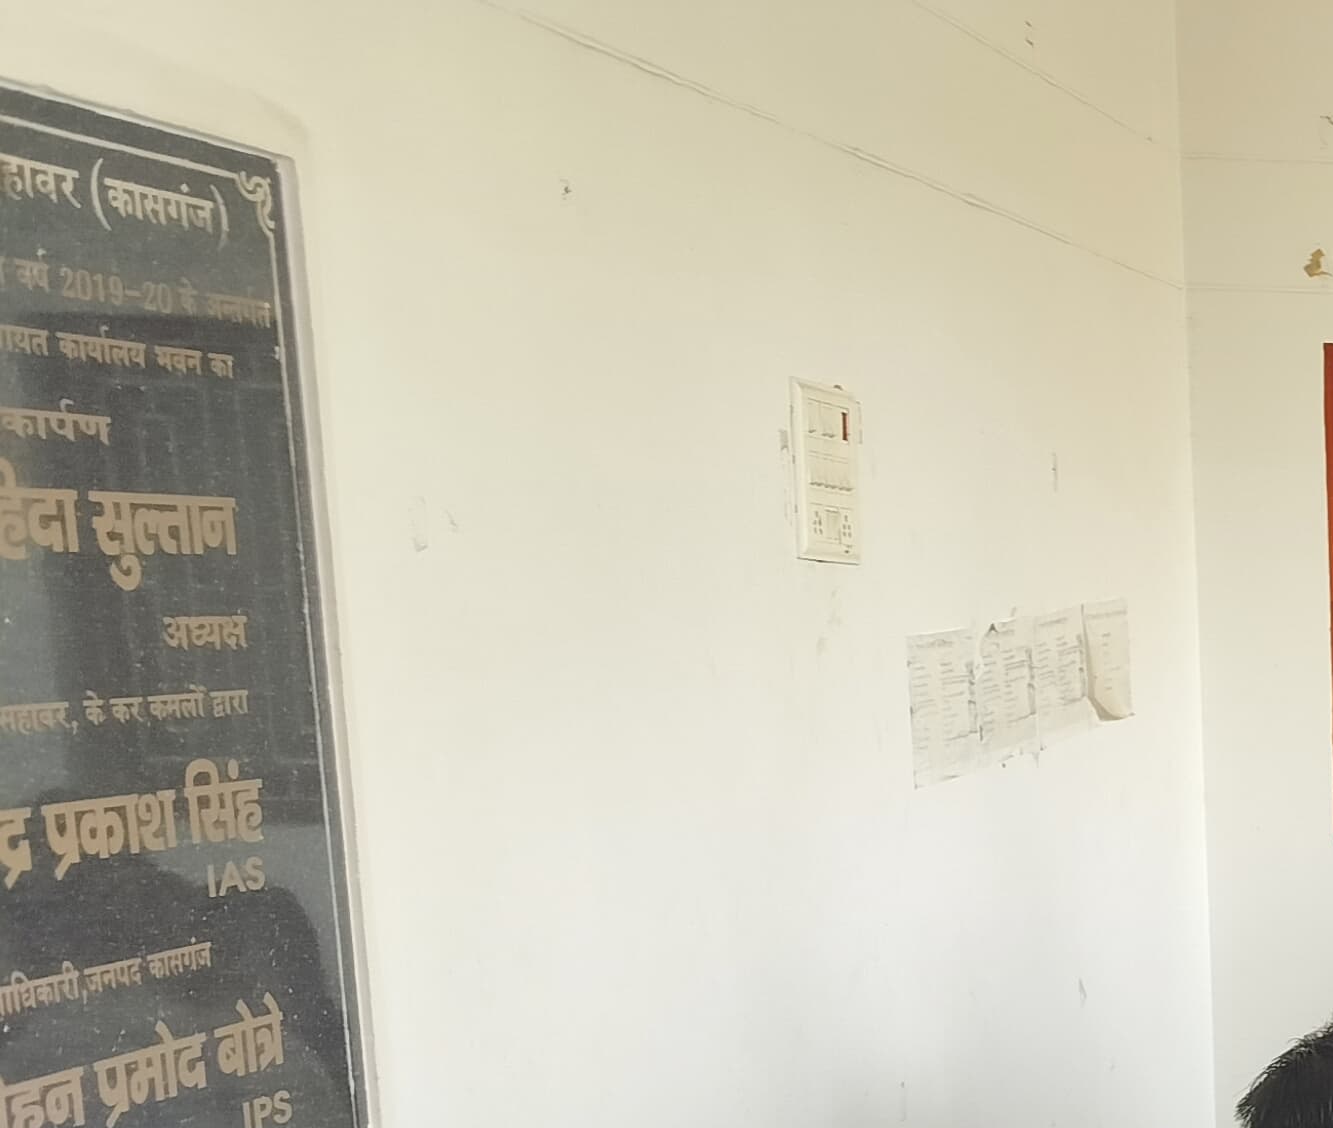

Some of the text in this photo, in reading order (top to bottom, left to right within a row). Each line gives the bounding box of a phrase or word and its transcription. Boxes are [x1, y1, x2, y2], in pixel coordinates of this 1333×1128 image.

[0, 154, 230, 249] हावर (कासगंज)
[55, 325, 146, 368] कार्यालय
[154, 345, 202, 374] भवन
[208, 353, 234, 378] का
[0, 399, 111, 445] कार्पण
[89, 491, 237, 591] सुल्तान
[163, 615, 248, 650] अध्यक्ष
[83, 690, 106, 725] के
[109, 697, 144, 723] कर
[147, 684, 207, 720] कमलों
[209, 689, 248, 717] द्वारा
[41, 789, 177, 880] प्रकाश
[184, 759, 264, 845] सिंह
[207, 856, 266, 898] IAS
[146, 937, 212, 979] कासगंज
